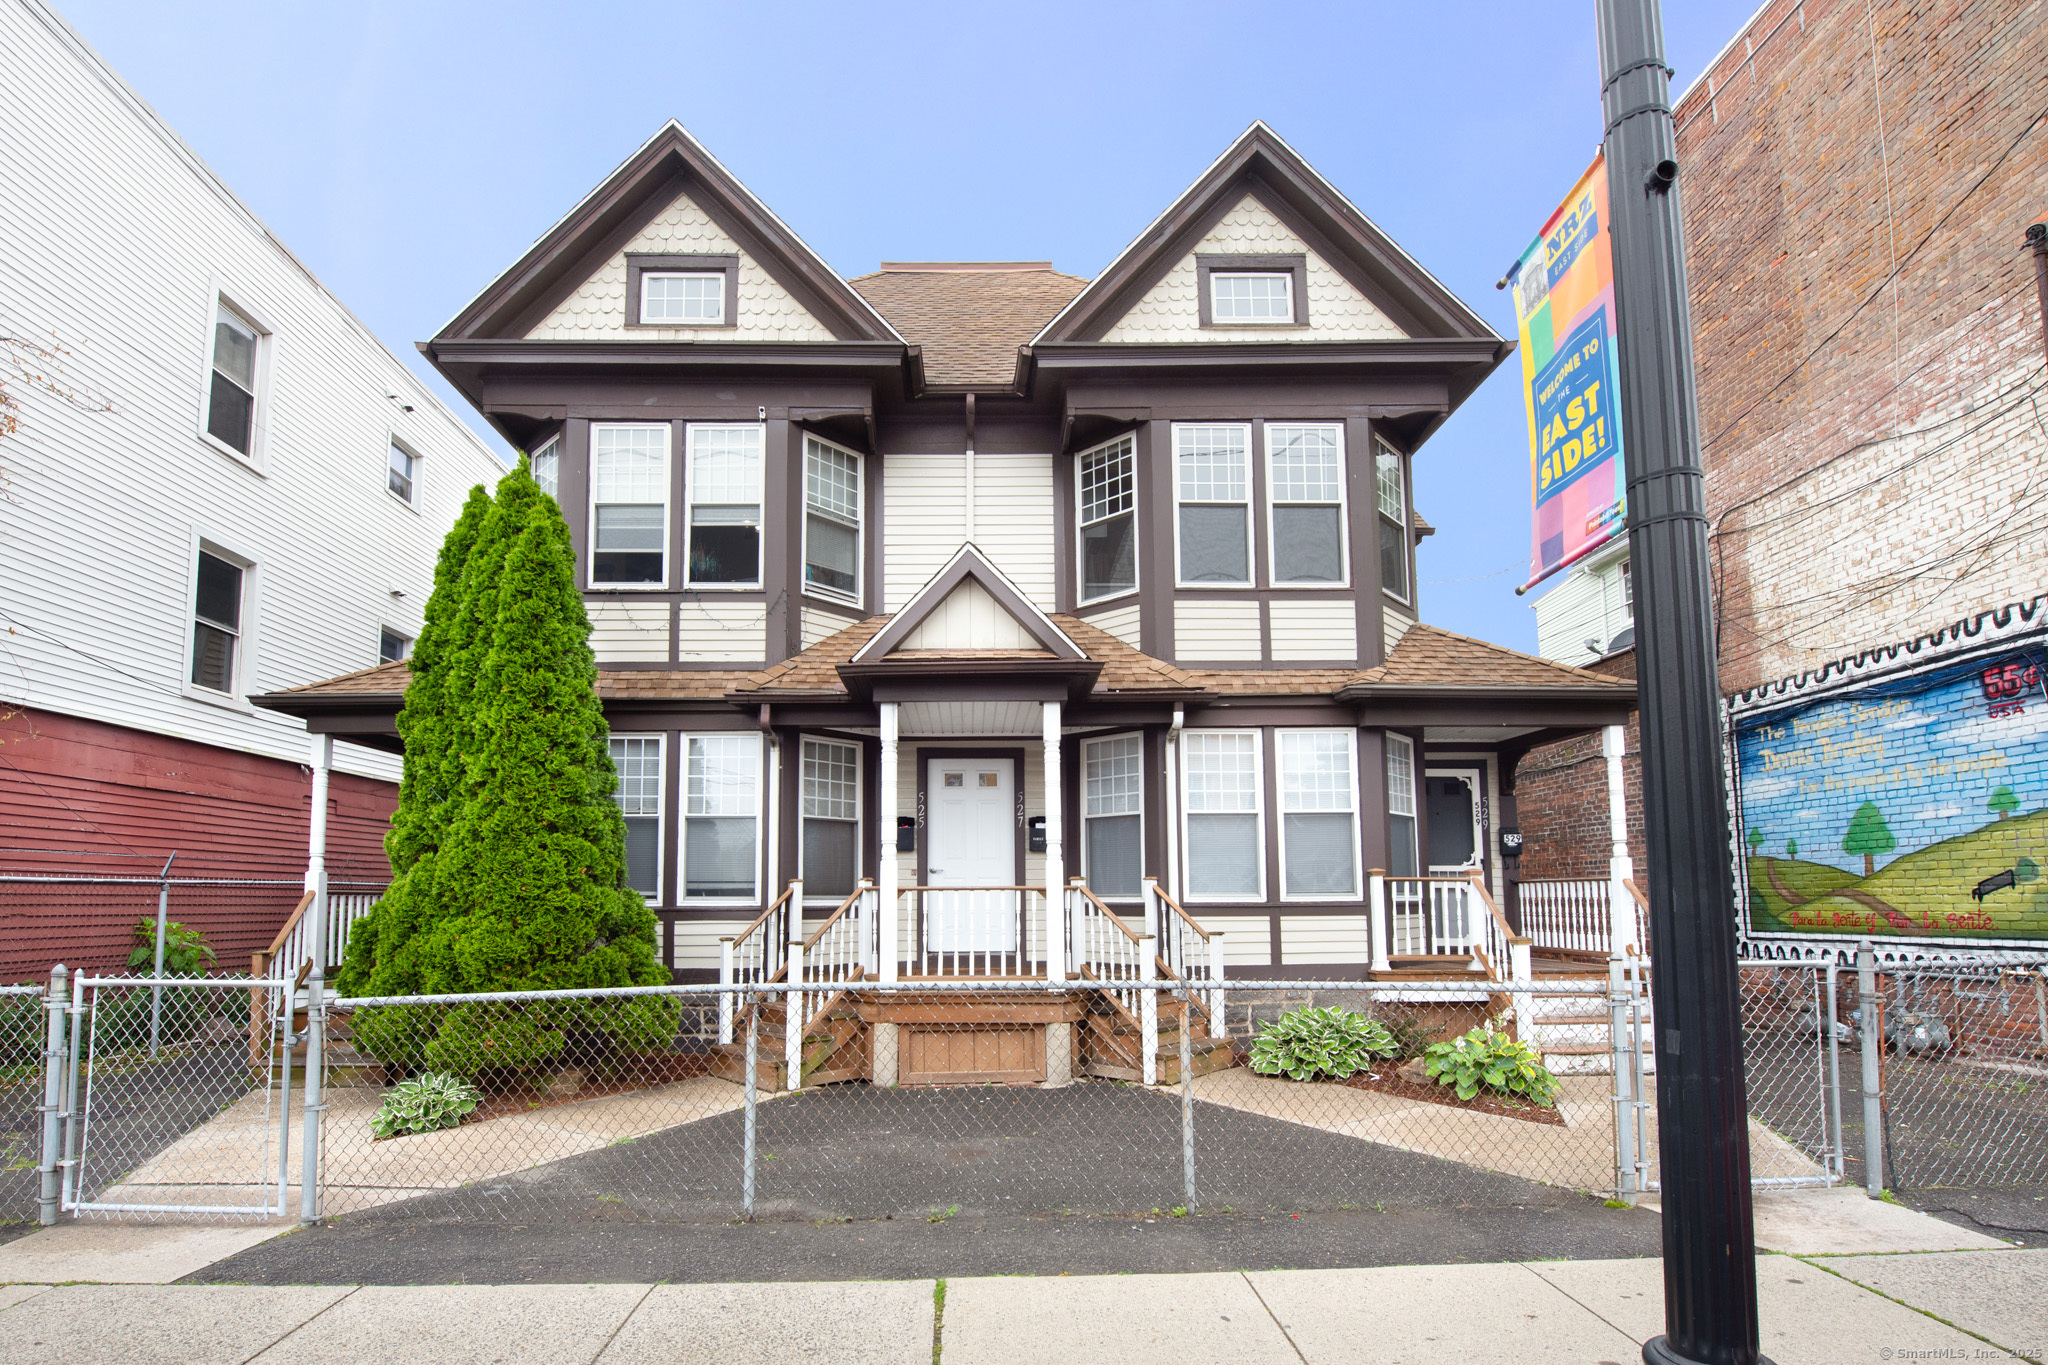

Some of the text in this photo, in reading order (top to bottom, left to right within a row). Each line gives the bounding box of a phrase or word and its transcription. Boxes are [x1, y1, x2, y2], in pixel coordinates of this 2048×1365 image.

[1546, 190, 1592, 262] NRZ
[1554, 228, 1588, 276] EAST SIDE
[1539, 338, 1599, 406] WELCOME TO
[1557, 385, 1571, 403] THE
[1542, 380, 1600, 456] EAST
[1541, 416, 1606, 490] SIDE!
[1755, 725, 1787, 743] The
[1851, 697, 1912, 724] Senator
[1989, 706, 2025, 719] USA
[1758, 730, 1884, 772] Dennis Bradley
[1799, 779, 1818, 795] For
[1824, 775, 1845, 791] the
[1927, 757, 1952, 778] the
[918, 791, 926, 828] 525
[1505, 834, 1521, 843] 529
[1789, 911, 1815, 929] Para
